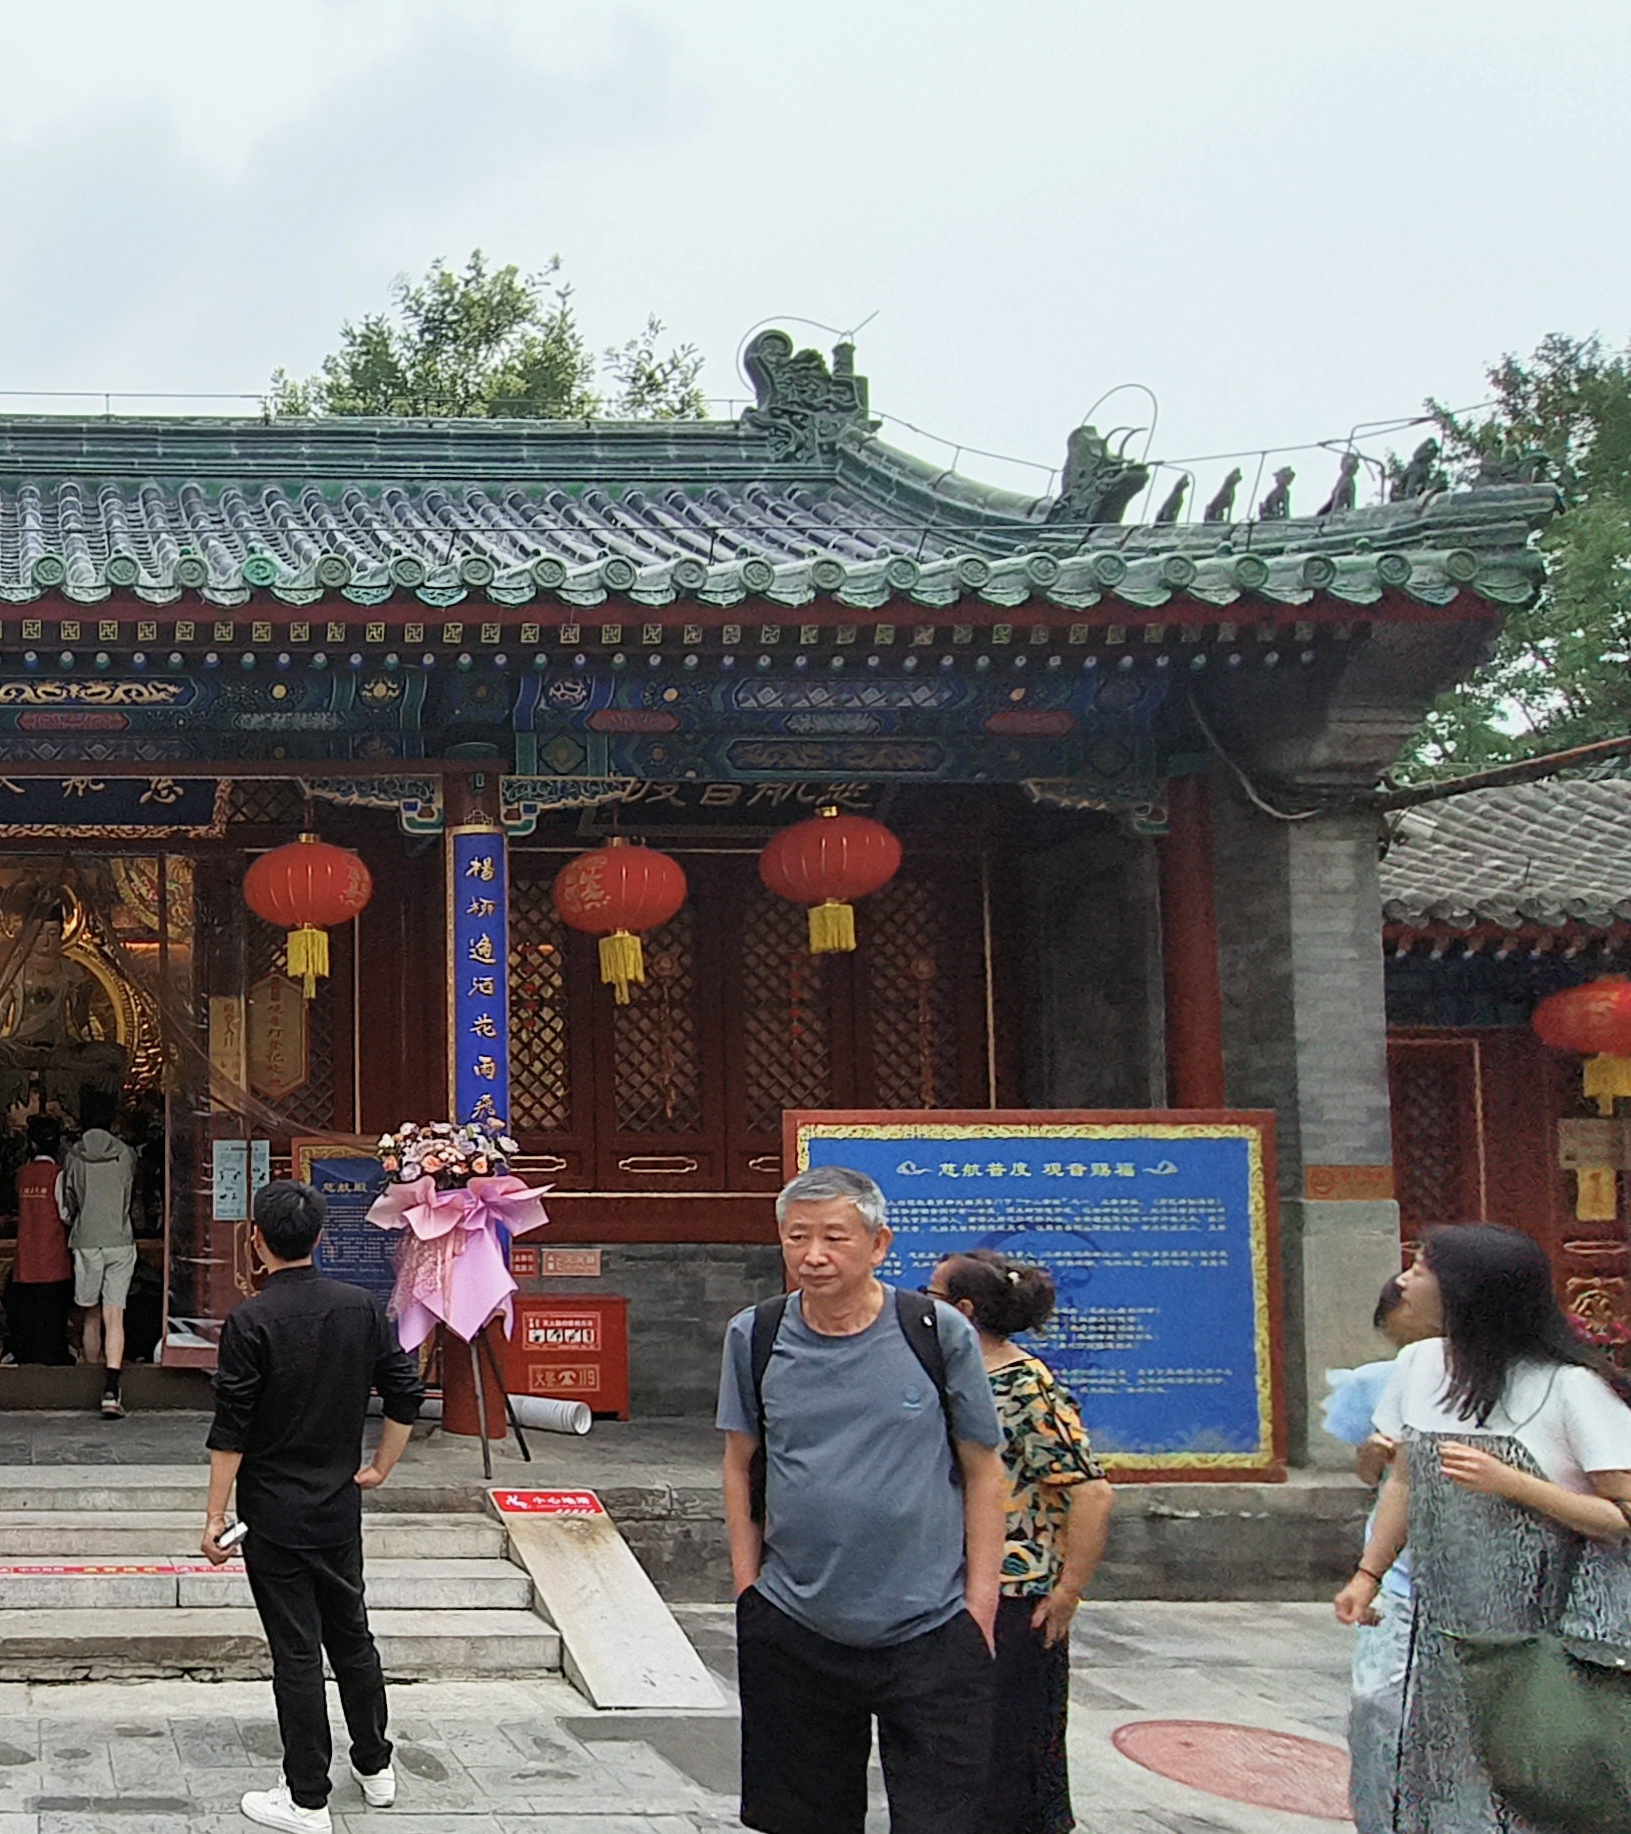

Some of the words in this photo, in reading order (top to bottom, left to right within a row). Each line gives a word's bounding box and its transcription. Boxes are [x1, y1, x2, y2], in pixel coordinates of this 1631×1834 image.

[937, 1162, 1033, 1178] 慈航普度
[1042, 1161, 1137, 1178] 观音赐福
[534, 1371, 557, 1387] 火警
[579, 1370, 595, 1386] 119
